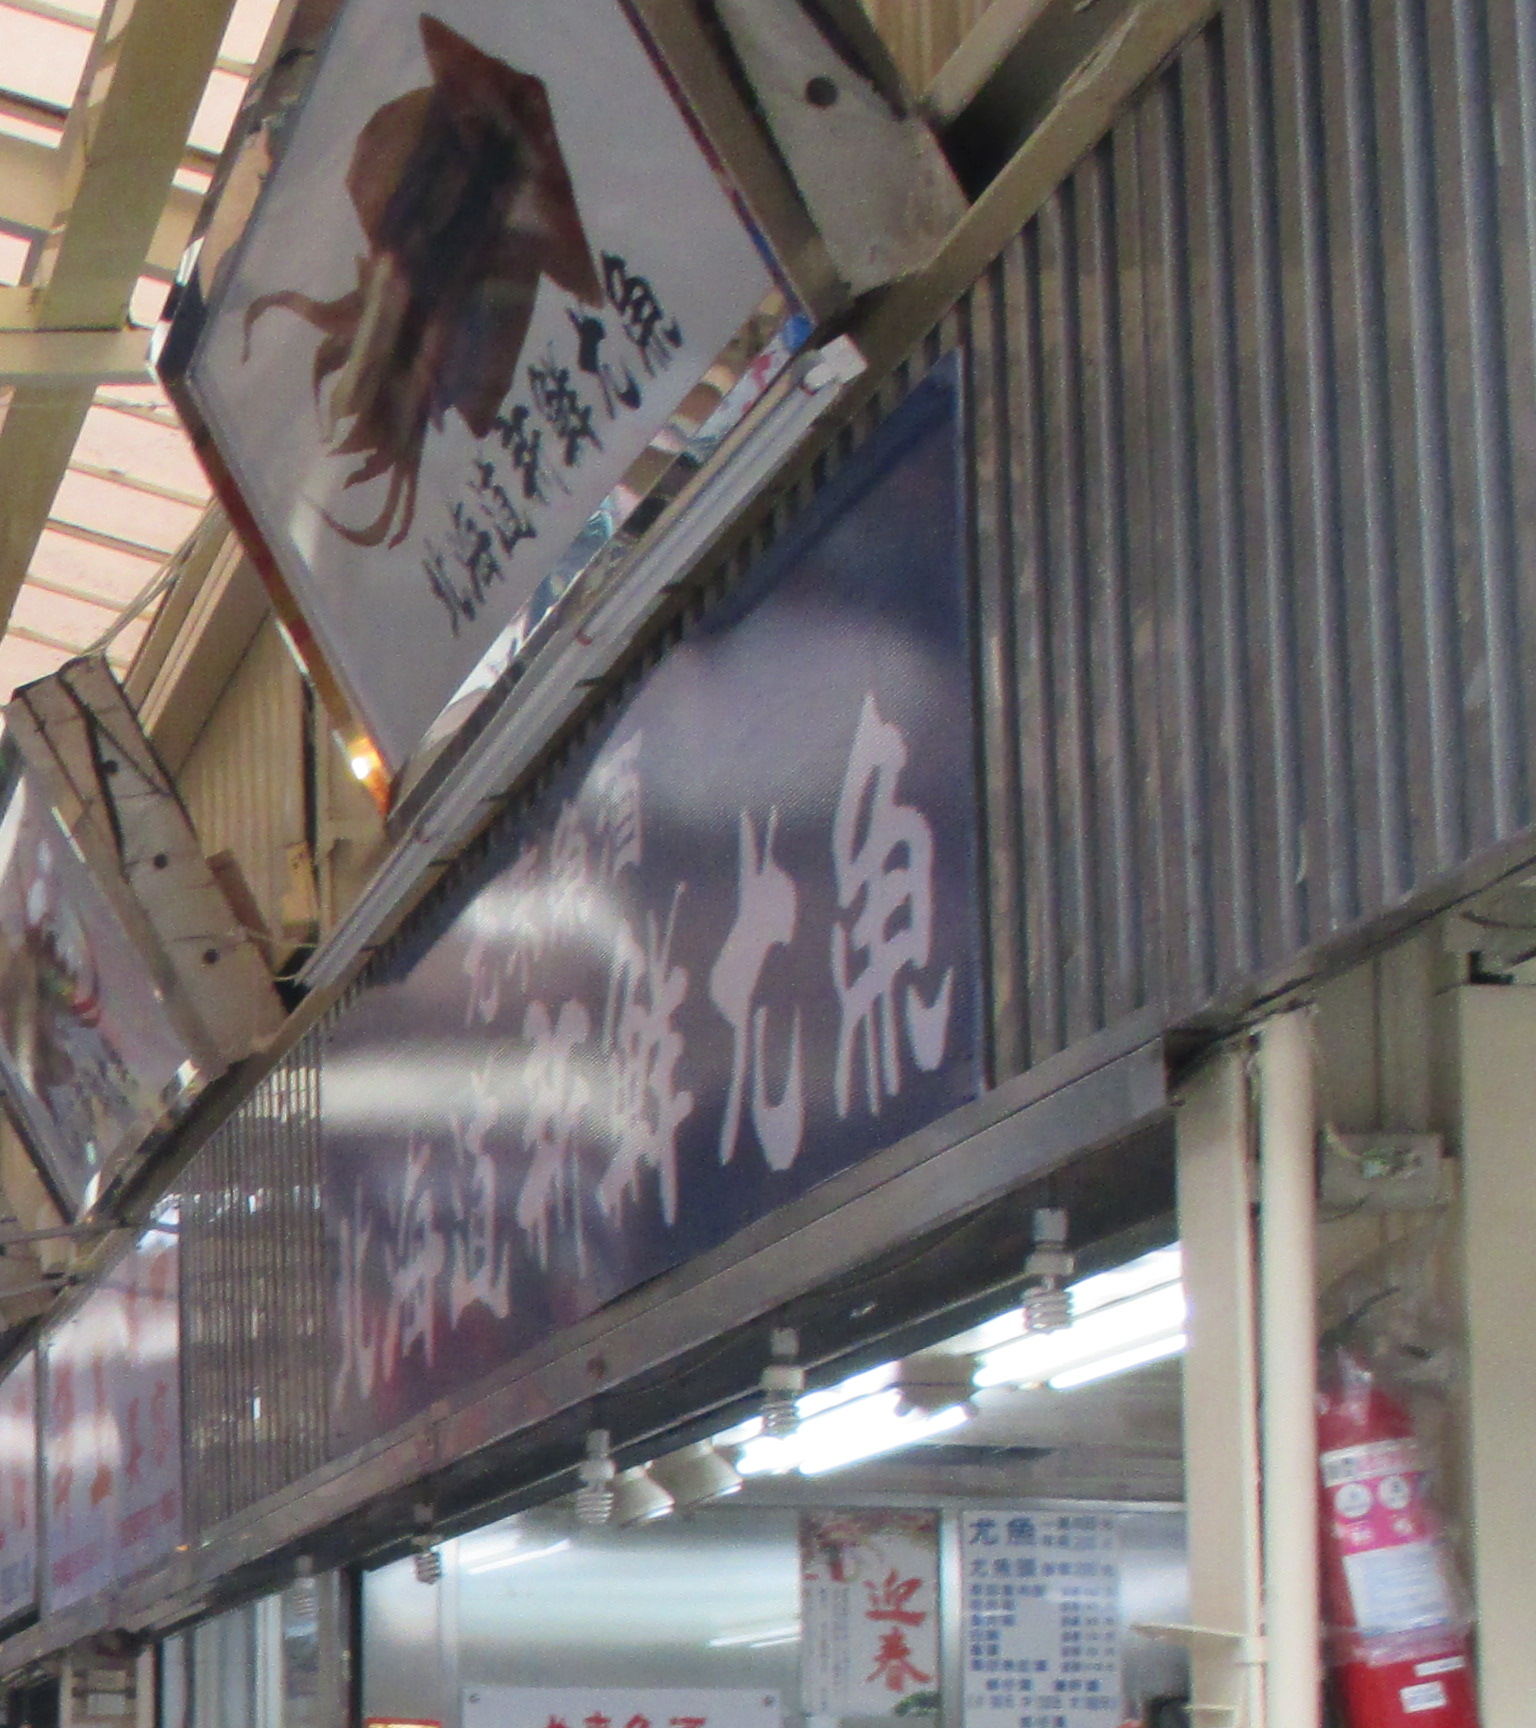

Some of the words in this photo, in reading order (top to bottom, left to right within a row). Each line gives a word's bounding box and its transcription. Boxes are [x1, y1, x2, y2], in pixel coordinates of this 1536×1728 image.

[335, 691, 956, 1402] 北海道新鮮尤魚
[864, 1567, 932, 1692] 迎春
